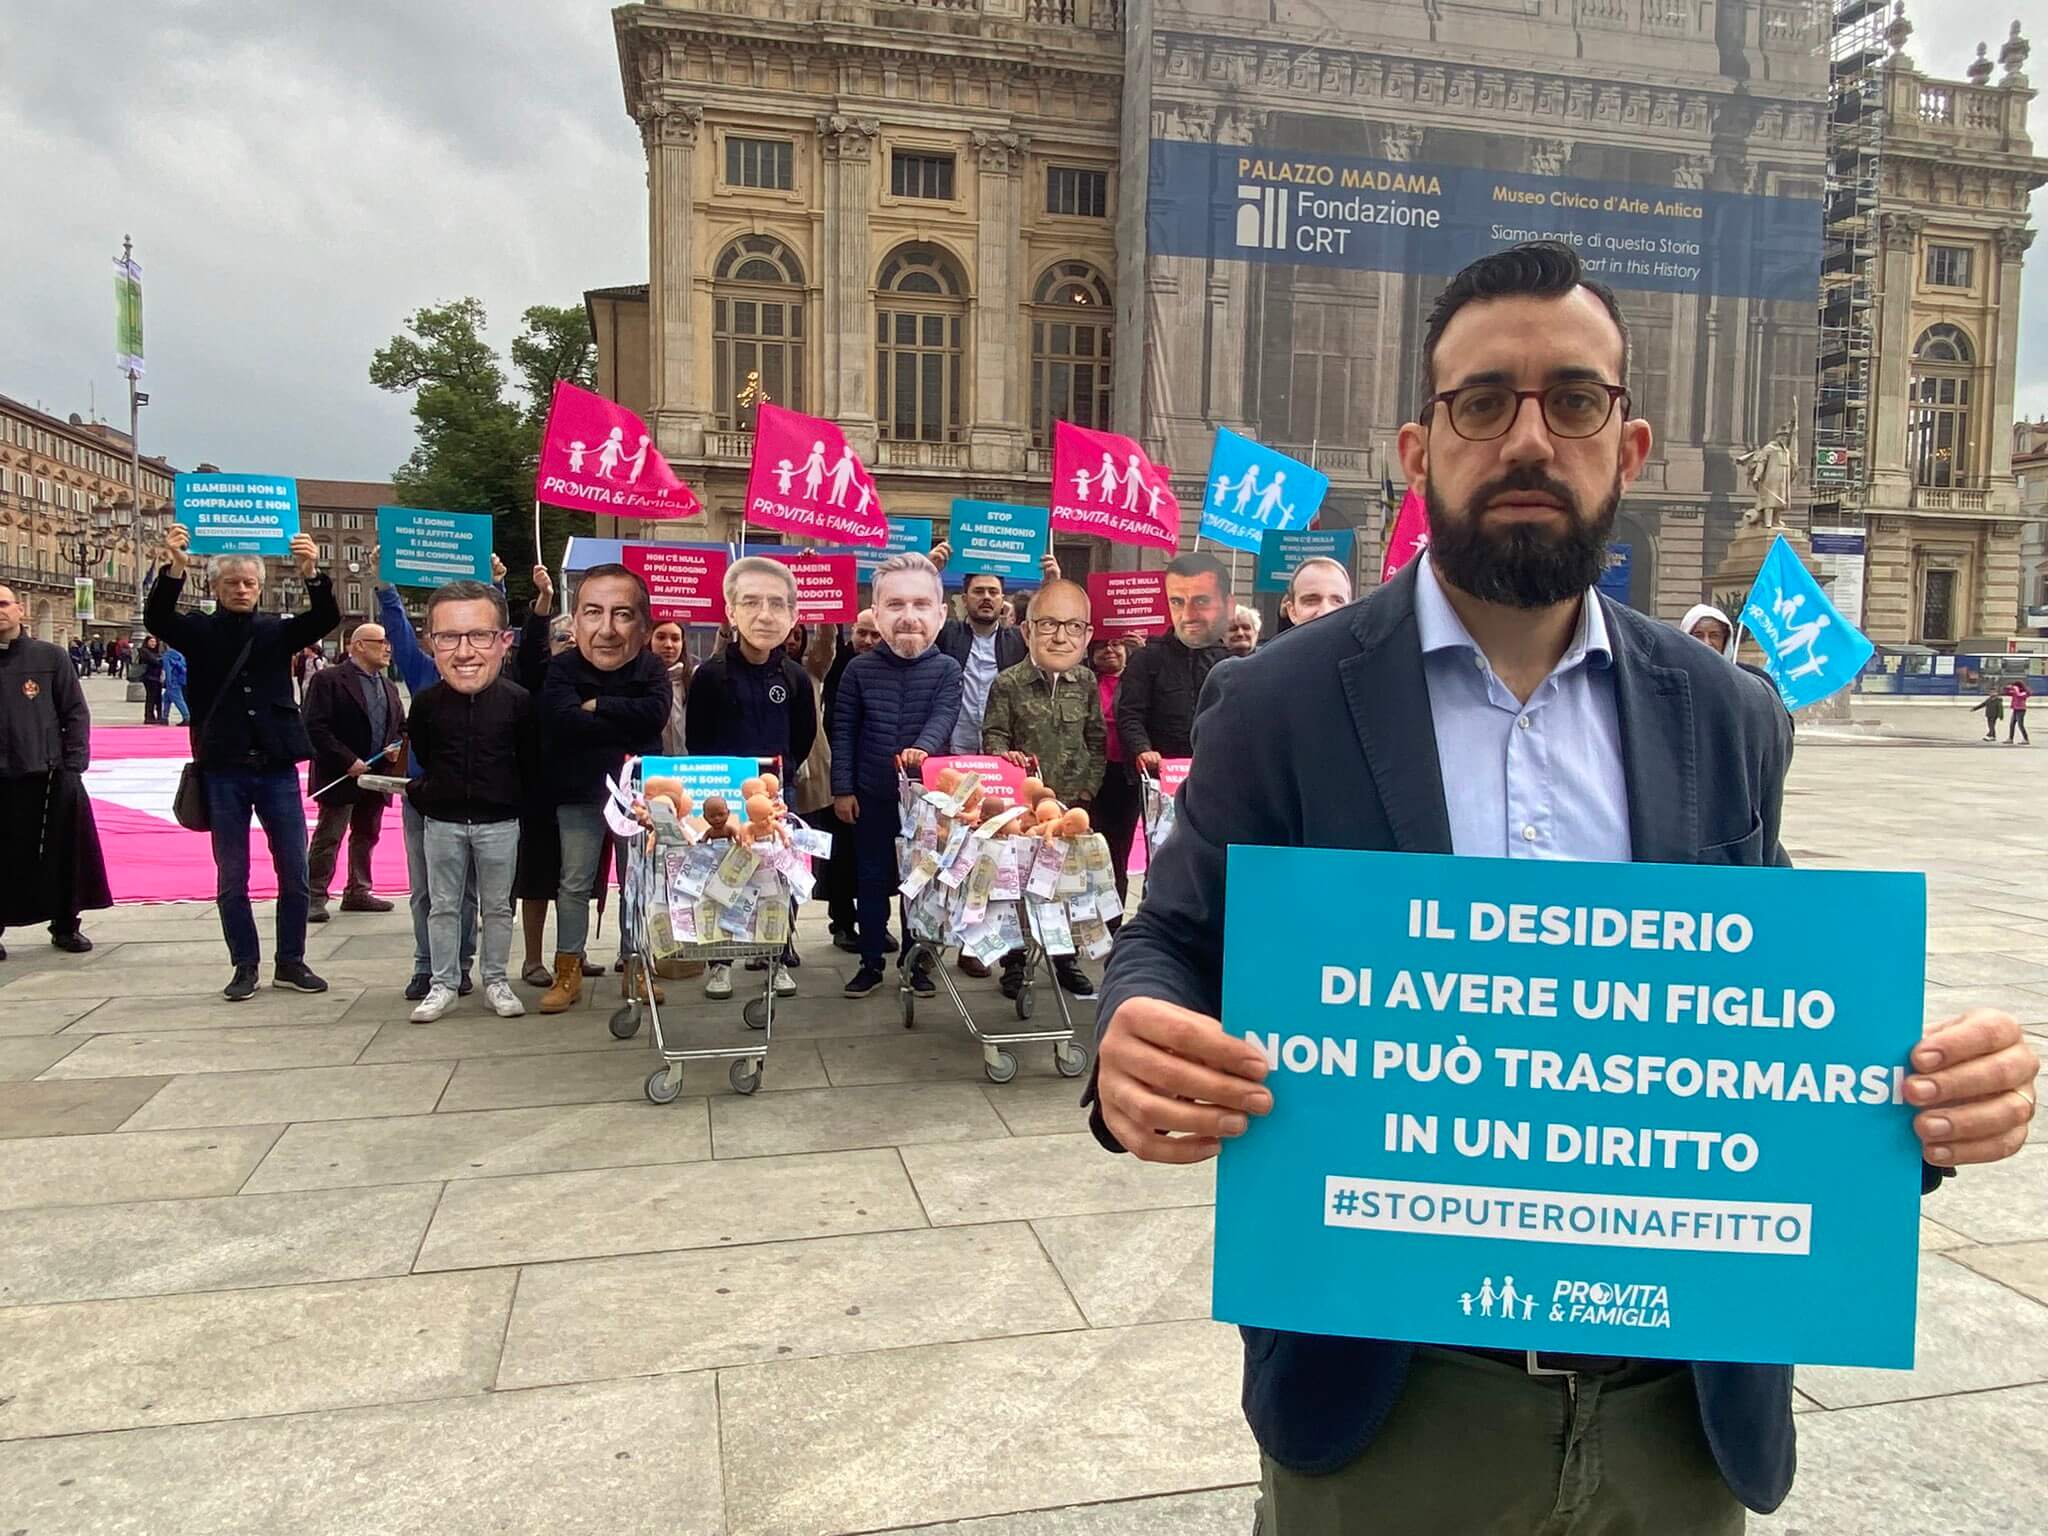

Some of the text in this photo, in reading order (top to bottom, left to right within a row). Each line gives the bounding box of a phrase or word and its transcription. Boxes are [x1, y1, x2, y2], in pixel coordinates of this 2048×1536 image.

[1239, 158, 1441, 196] PALAZZO MADAMA
[1297, 191, 1441, 229] Fondazione
[1492, 185, 1703, 219] Museo Civico d'Arte Antica
[1296, 225, 1351, 254] CRT
[1588, 232, 1601, 248] di
[1605, 236, 1656, 253] questa
[1659, 238, 1700, 256] Storia
[1610, 258, 1622, 272] in
[1627, 258, 1649, 275] this
[1653, 261, 1701, 281] History
[186, 483, 286, 496] I BAMBINI NON SI
[543, 476, 610, 503] PROVITA
[611, 490, 625, 504] &
[183, 498, 291, 511] COMPRANO E NON
[198, 514, 279, 524] SI REGALANO
[412, 516, 422, 525] LE
[752, 498, 884, 539] PROVITA & FAMIGLIA
[987, 511, 1013, 521] STOP
[1052, 505, 1110, 526] PROVITA
[1109, 516, 1118, 528] &
[395, 526, 473, 540] NON SI AFFITTANO
[960, 523, 1036, 538] AL MERCIMONIO
[971, 537, 1024, 550] DEI GAMETI
[396, 548, 415, 557] NON
[426, 551, 474, 562] COMPRANO
[646, 553, 705, 564] NON C'È NULLA
[654, 563, 667, 572] PIÙ
[650, 575, 699, 584] DELL'UTERO
[806, 577, 834, 585] SONO
[664, 586, 696, 594] AFFITTO
[796, 589, 843, 598] RODOTTO
[699, 775, 732, 784] SONO
[1408, 898, 1753, 953] IL DESIDERIO
[1321, 966, 1834, 1029] DI AVERE UN FIGLIO
[1245, 1030, 1904, 1105] NON PUÒ TRASFORMARSI
[1385, 1113, 1759, 1172] IN UN DIRITTO
[1332, 1187, 1802, 1243] #STOPUTEROINAFFITTO
[1552, 1280, 1669, 1309] PROVITA
[1548, 1303, 1671, 1328] & FAMIGLIA
